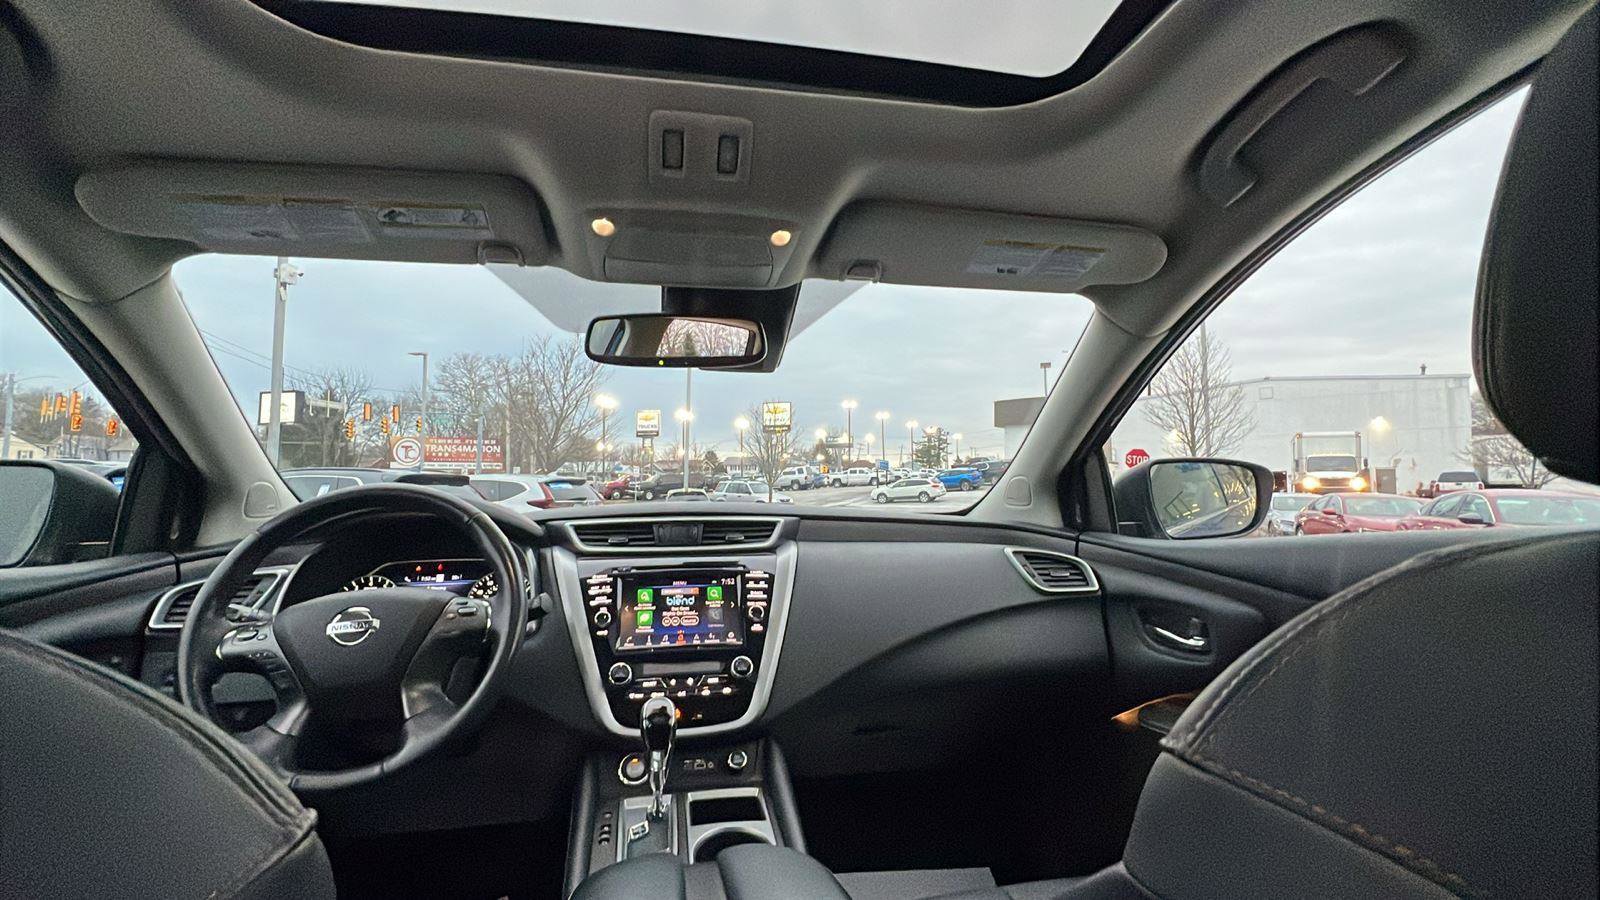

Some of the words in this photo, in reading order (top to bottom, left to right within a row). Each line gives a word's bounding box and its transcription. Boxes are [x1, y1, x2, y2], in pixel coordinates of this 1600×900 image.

[425, 445, 501, 453] TRANS4MAION
[1127, 455, 1149, 465] STOP
[666, 596, 695, 605] blend
